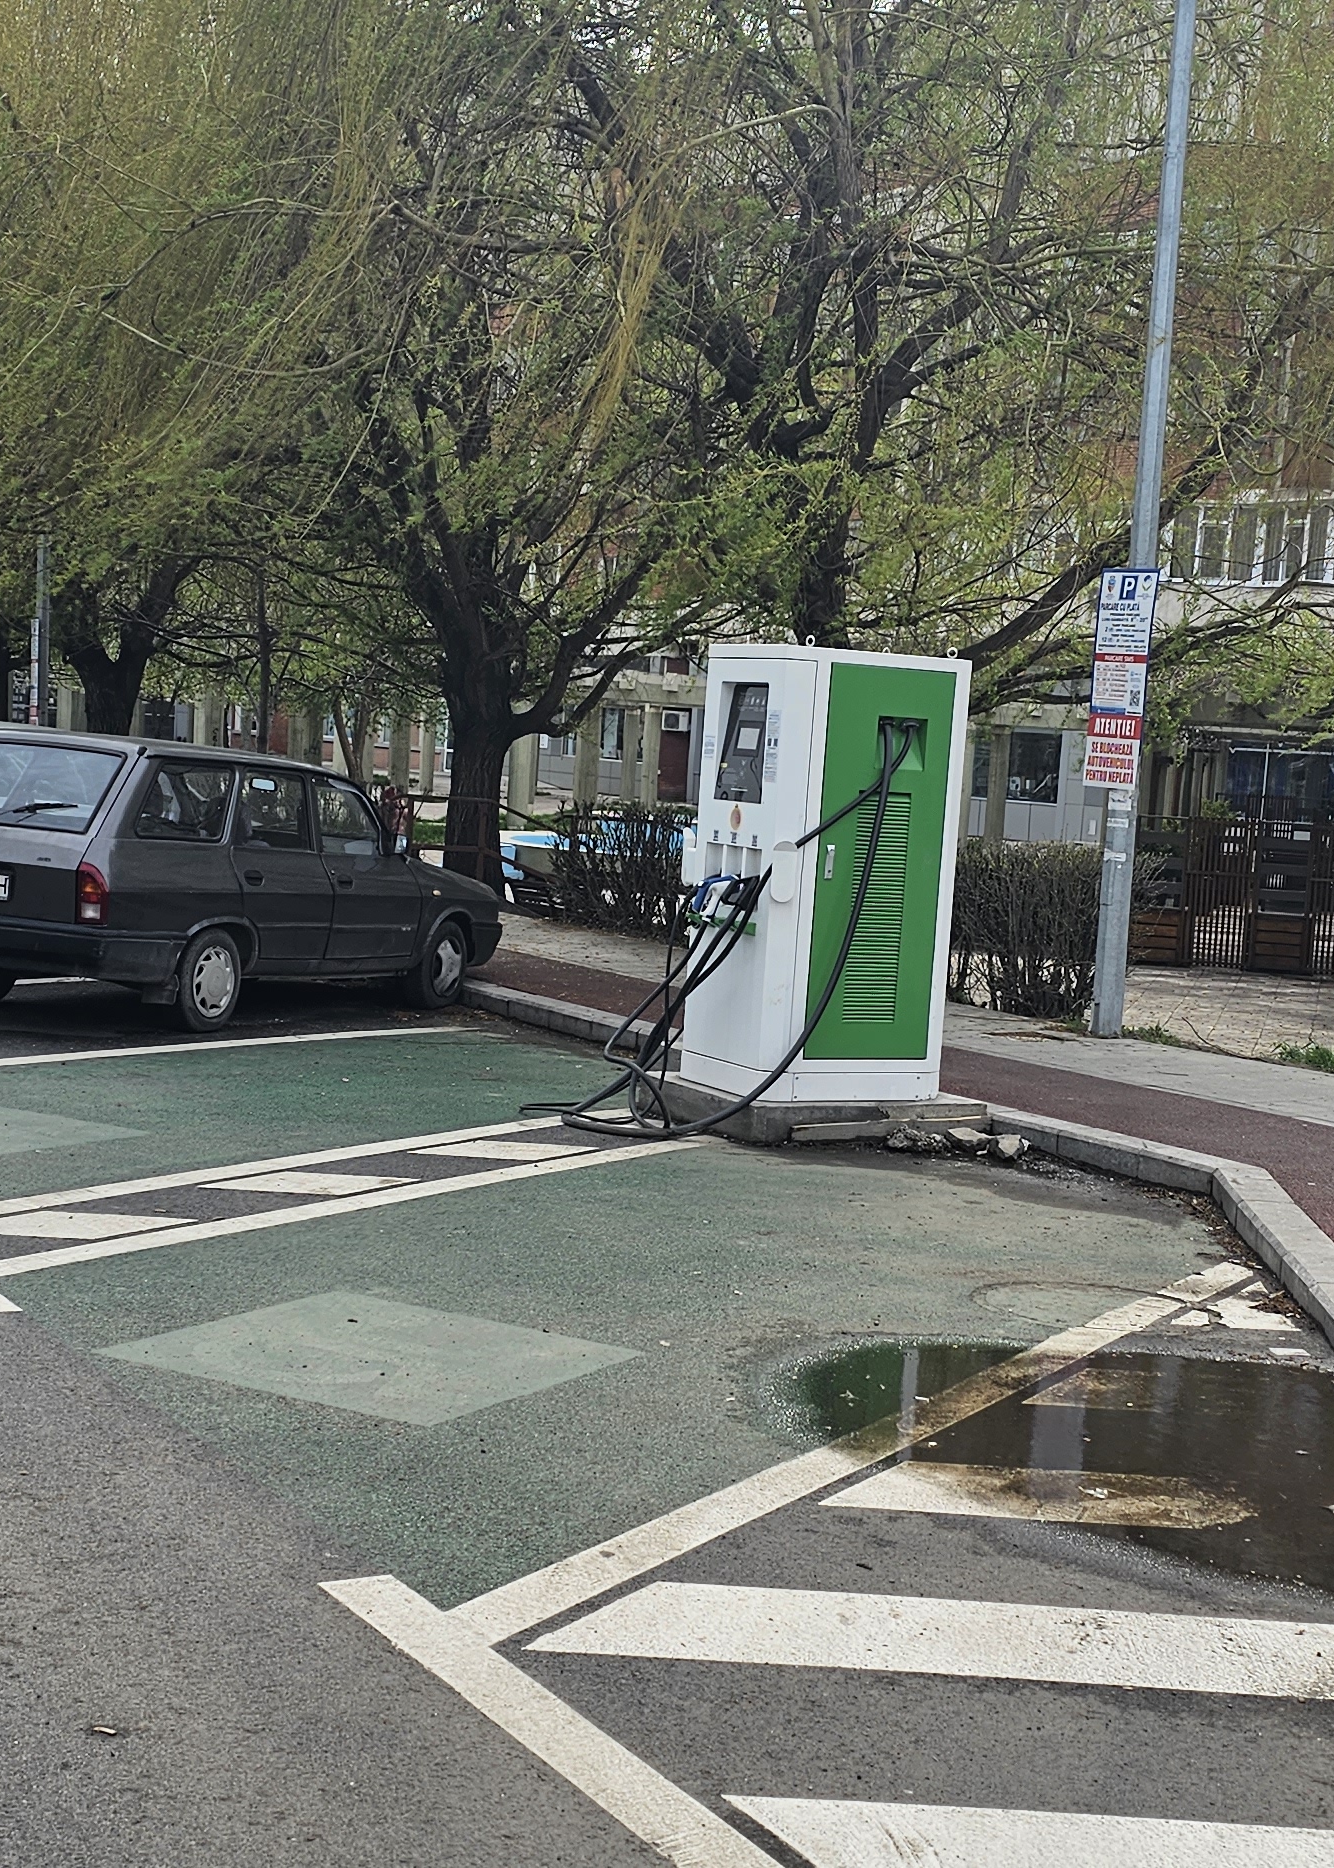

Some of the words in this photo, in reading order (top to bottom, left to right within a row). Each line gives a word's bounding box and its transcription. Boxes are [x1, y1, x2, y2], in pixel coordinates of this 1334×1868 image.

[1122, 577, 1136, 598] P
[1091, 741, 1099, 753] SE
[1085, 768, 1107, 783] PENTRU
